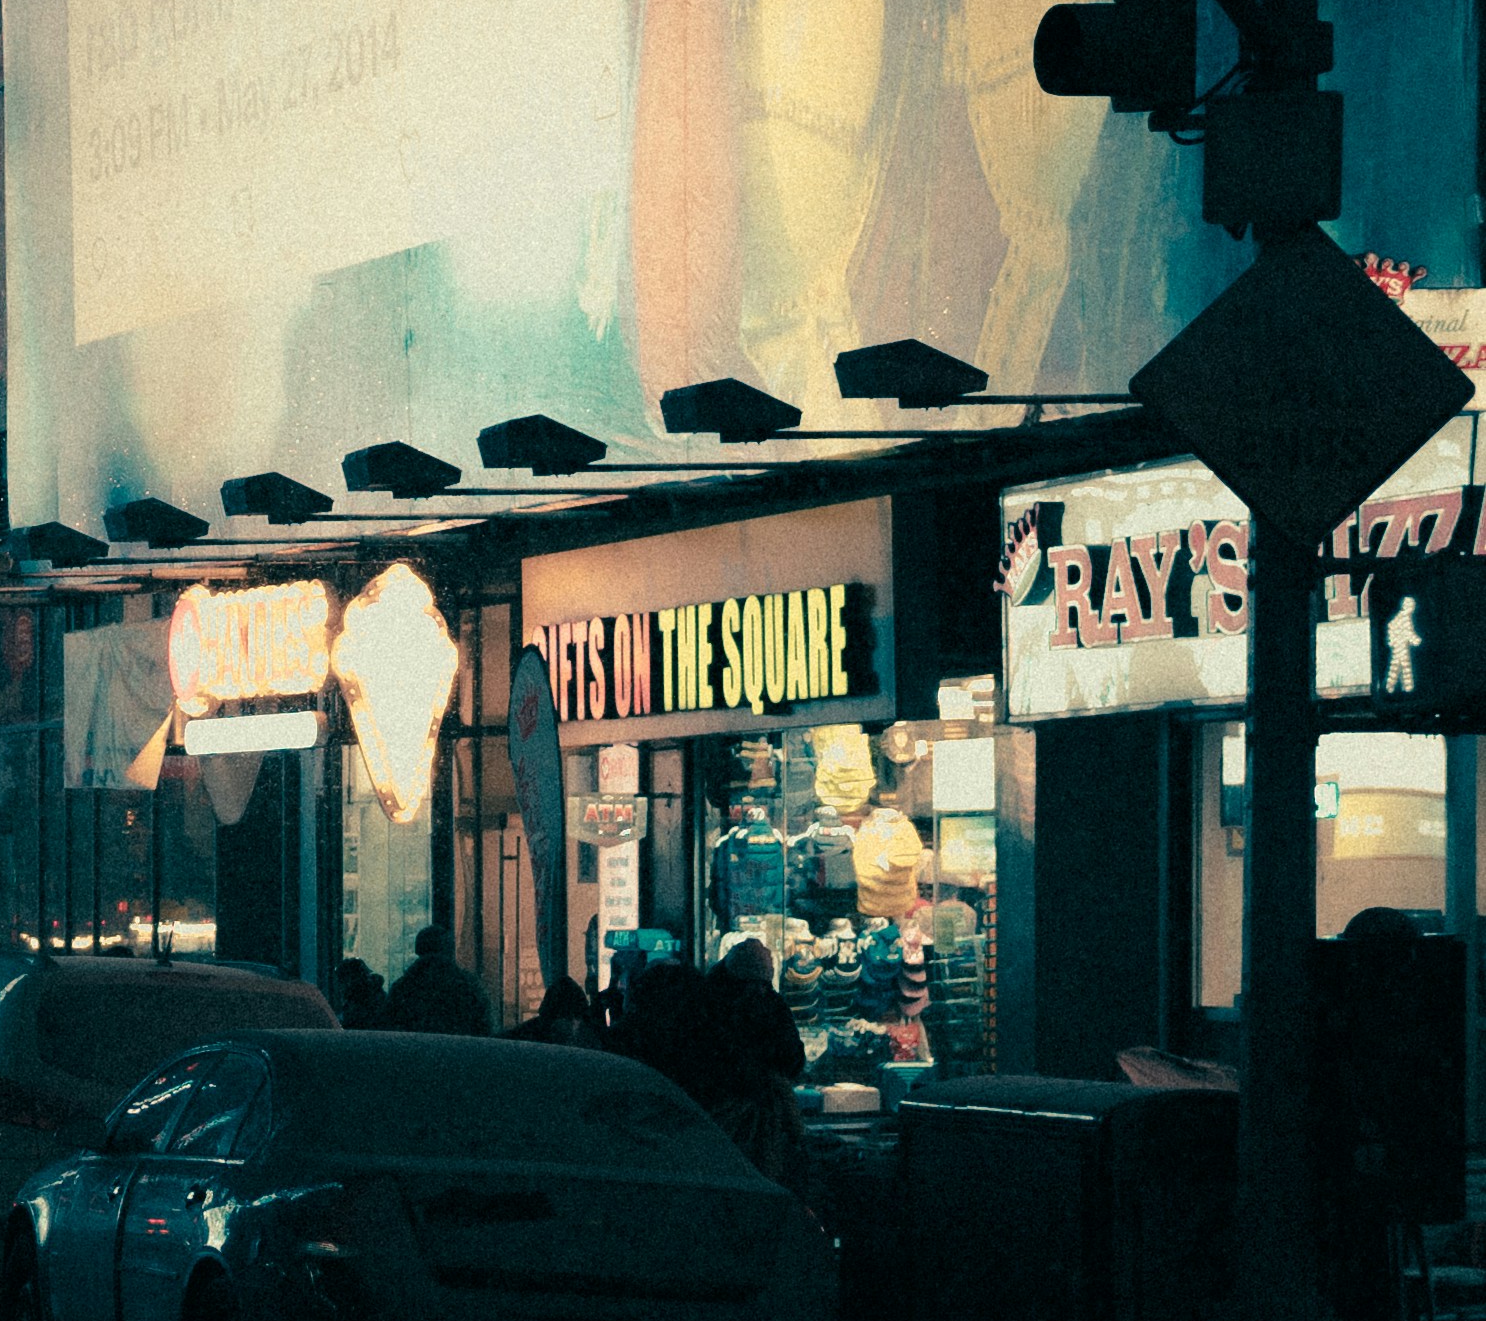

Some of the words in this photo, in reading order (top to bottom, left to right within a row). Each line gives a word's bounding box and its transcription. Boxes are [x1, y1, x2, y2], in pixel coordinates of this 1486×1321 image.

[88, 110, 143, 183] 3:09
[149, 90, 192, 161] PM
[328, 8, 402, 94] 2014
[613, 611, 652, 719] ON
[658, 602, 714, 712] THE
[721, 583, 849, 716] SQUARE
[1047, 519, 1247, 651] RAY'S
[583, 803, 634, 823] ATM
